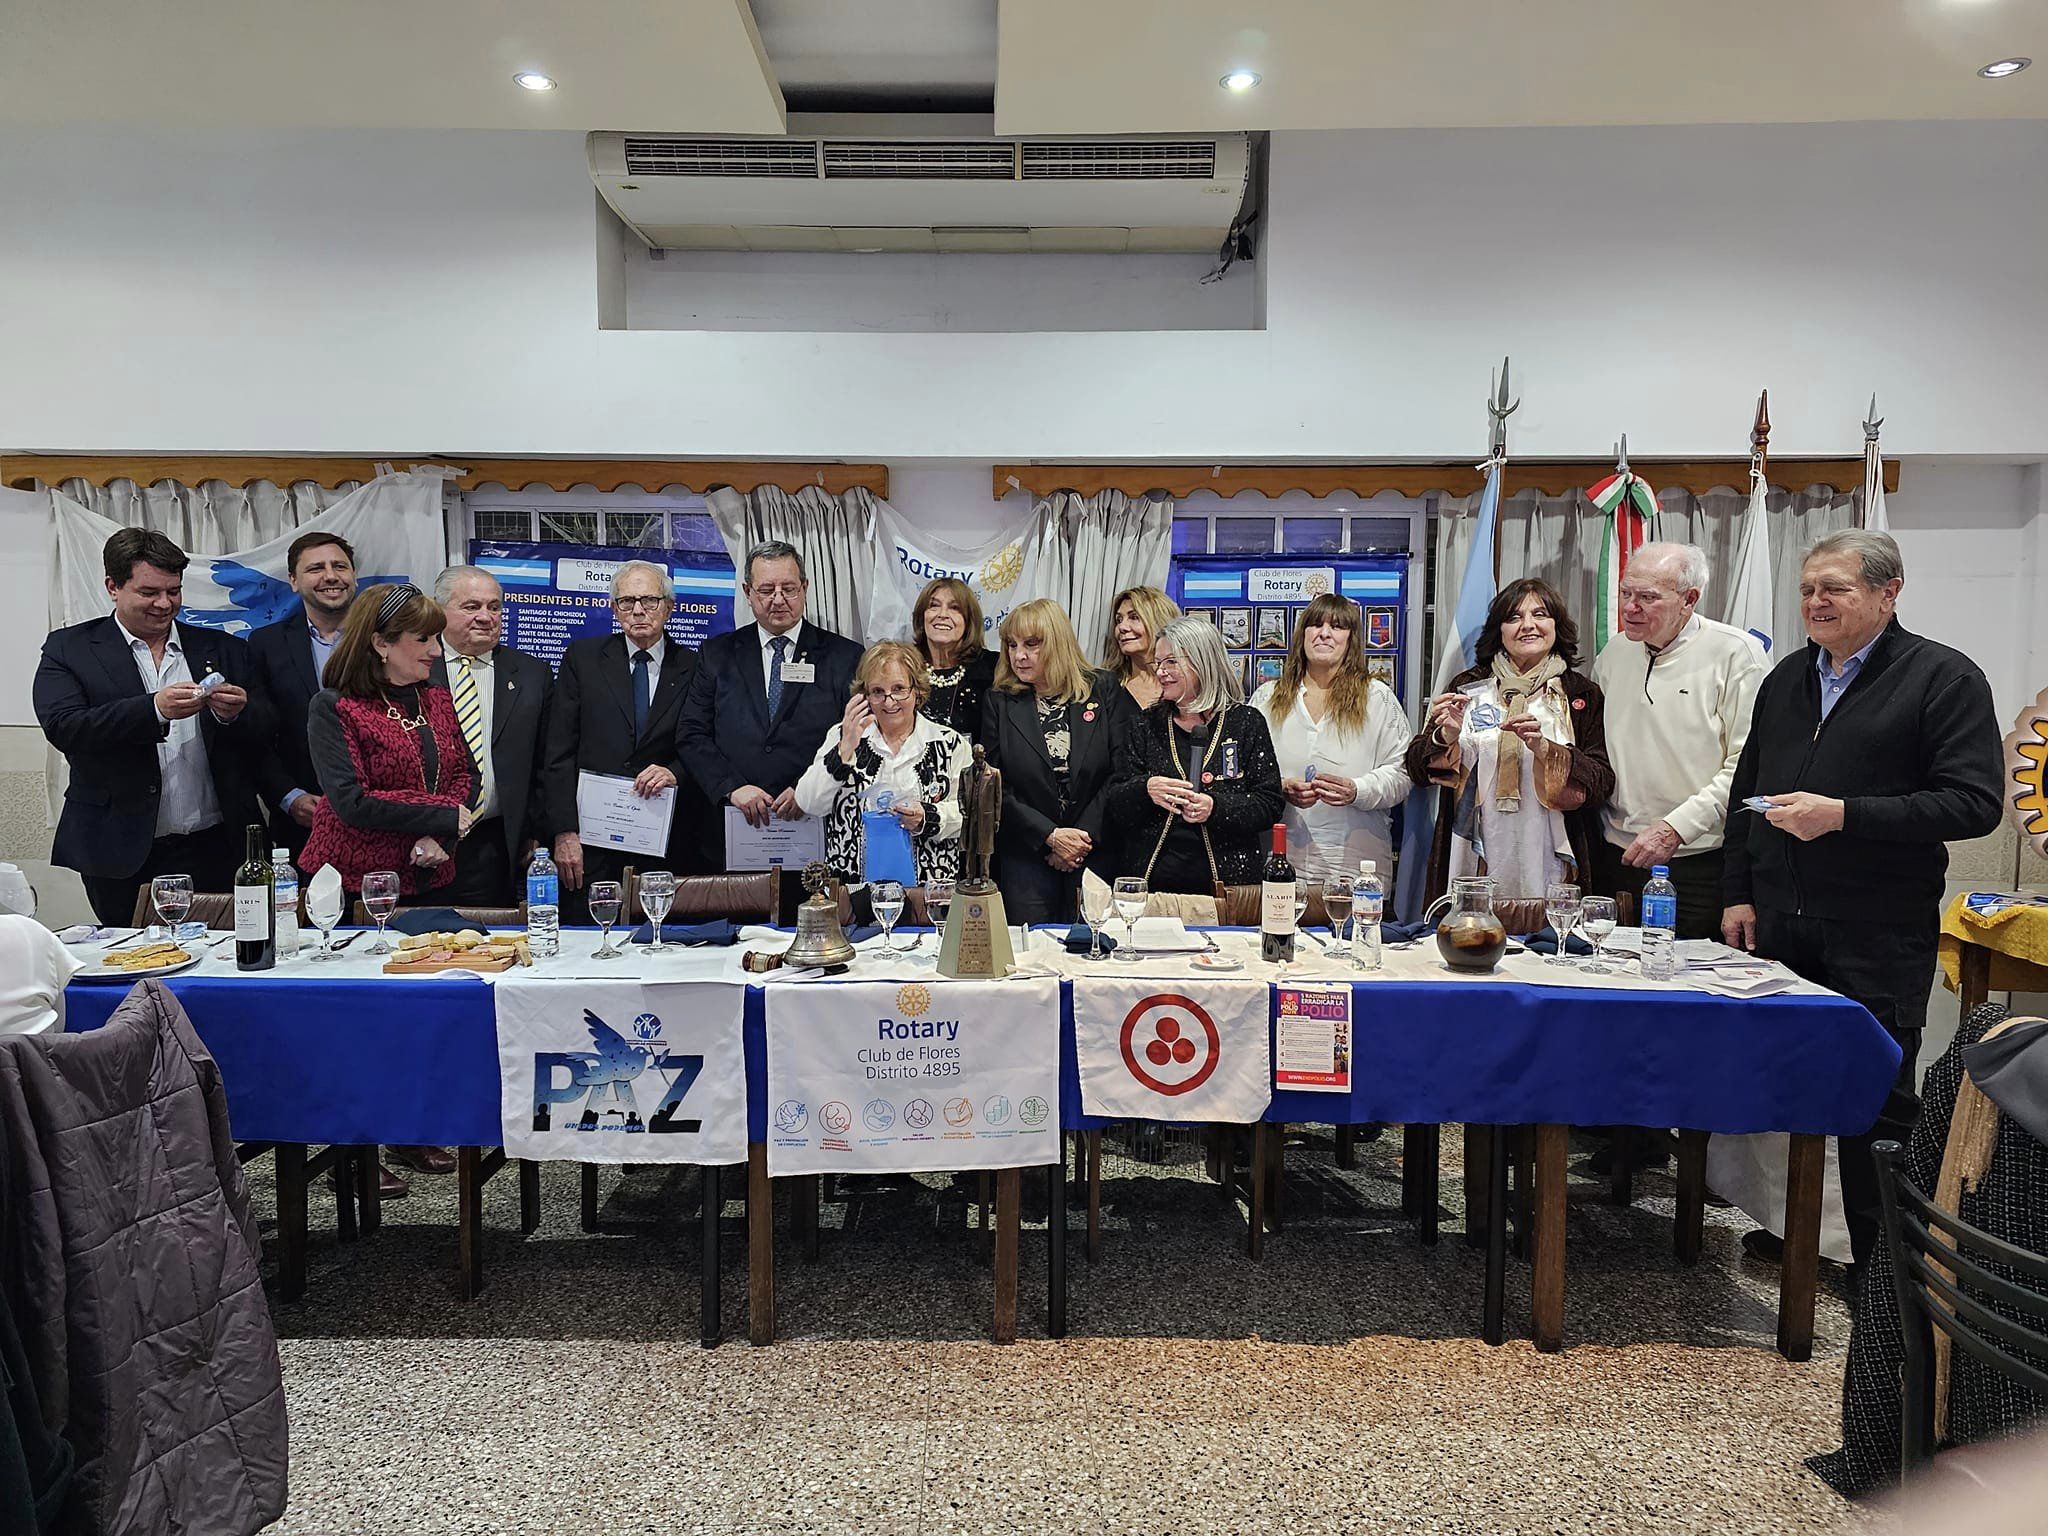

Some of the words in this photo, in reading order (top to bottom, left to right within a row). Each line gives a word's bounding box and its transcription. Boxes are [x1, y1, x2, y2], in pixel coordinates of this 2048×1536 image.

[604, 562, 621, 570] Flore
[586, 570, 612, 582] Rota
[1264, 579, 1302, 591] Rotary
[504, 592, 572, 606] PRESIDENTES
[575, 597, 589, 606] DE
[680, 603, 718, 614] FLORES
[1300, 1005, 1344, 1018] POLIO
[878, 1018, 959, 1040] Rotary
[858, 1048, 891, 1062] Club
[896, 1048, 914, 1060] de
[920, 1046, 960, 1060] Flores
[866, 1064, 918, 1080] Distrito
[922, 1062, 960, 1077] 4895
[533, 1052, 704, 1133] PAZ
